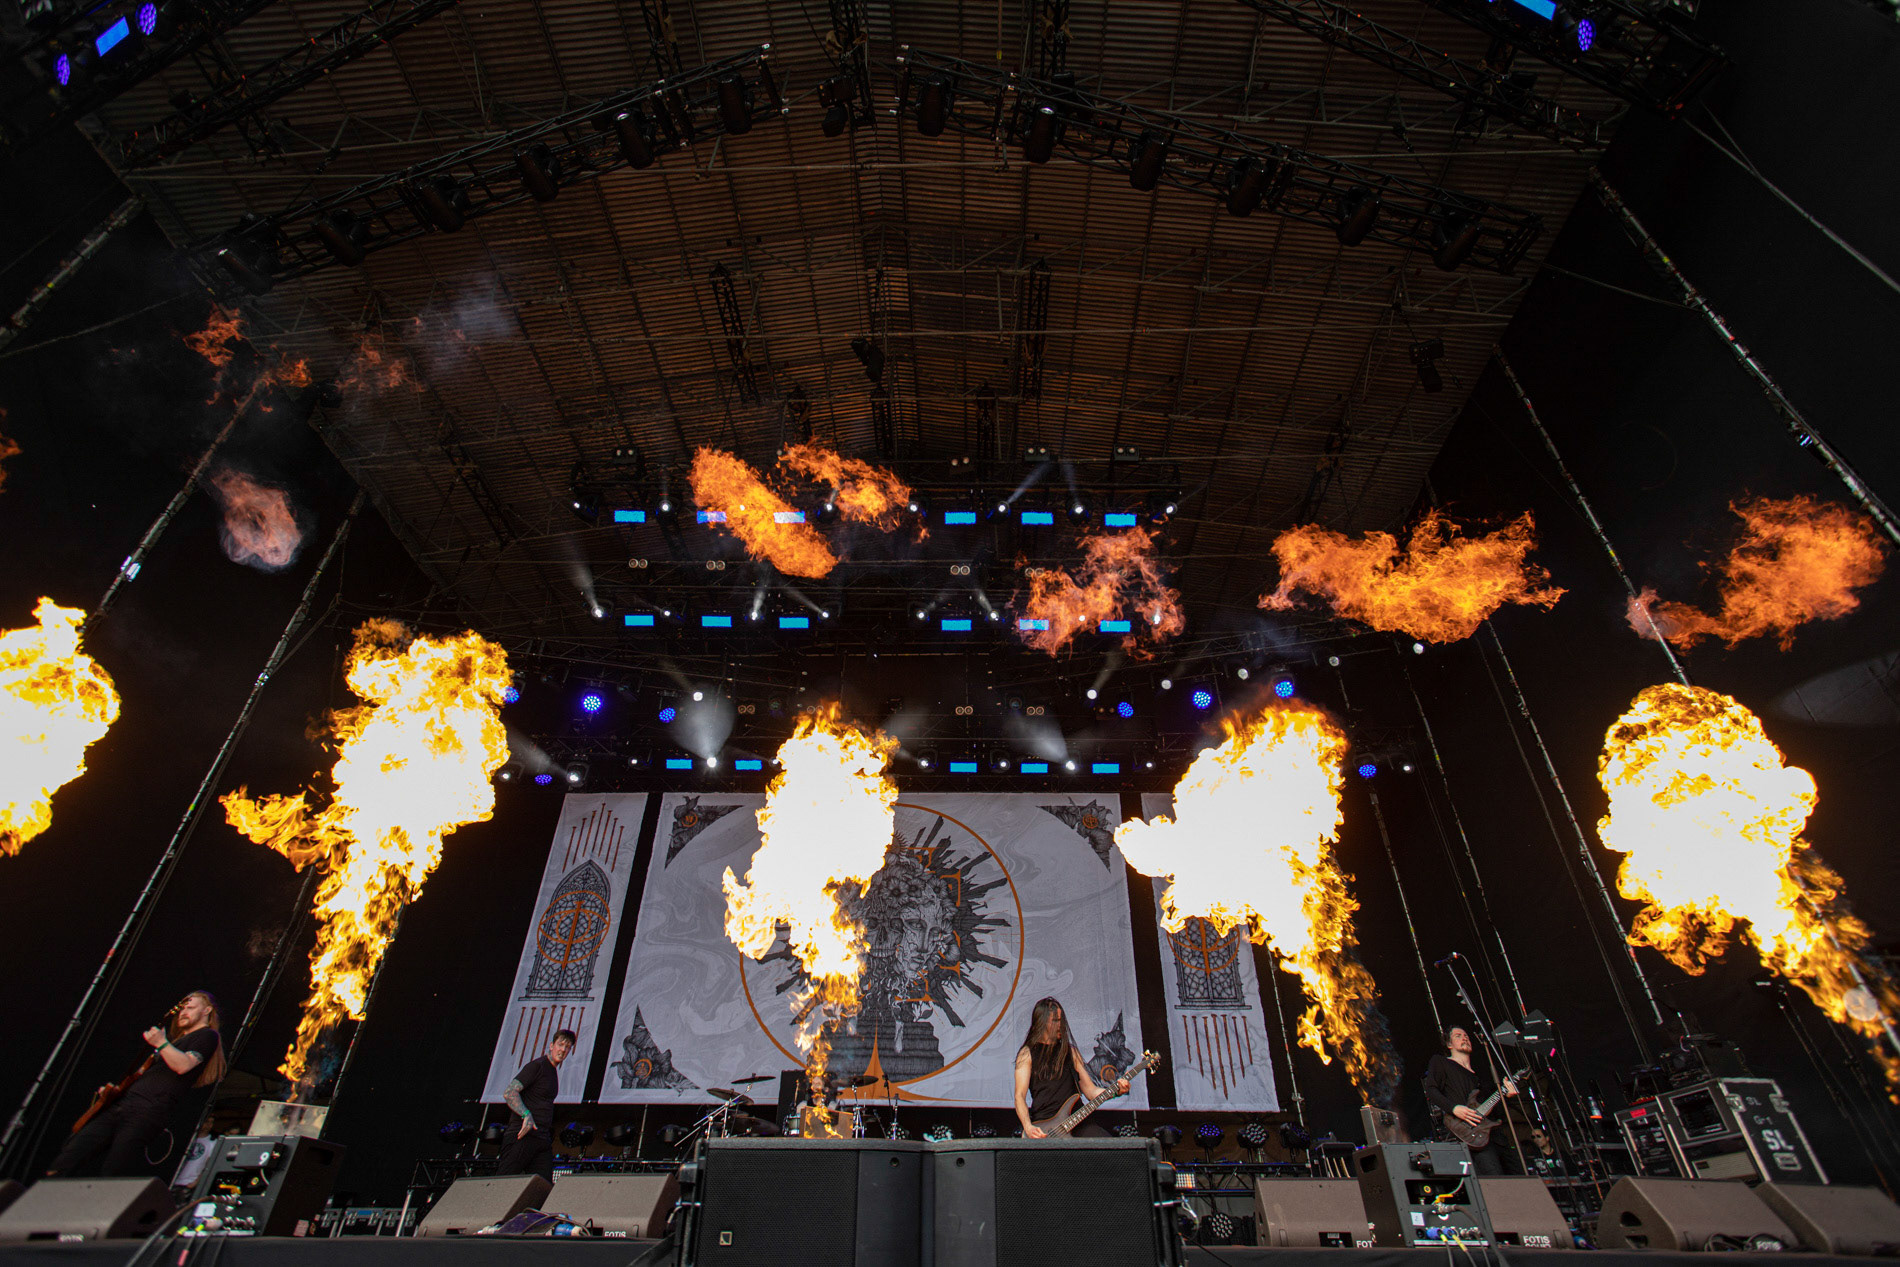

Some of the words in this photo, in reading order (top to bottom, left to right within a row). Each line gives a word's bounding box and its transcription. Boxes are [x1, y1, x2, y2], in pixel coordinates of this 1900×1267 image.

[1746, 1096, 1762, 1106] SL
[1761, 1129, 1795, 1151] SL
[259, 1151, 270, 1166] 9
[1459, 1161, 1470, 1175] 7
[1523, 1235, 1551, 1244] FOTIS
